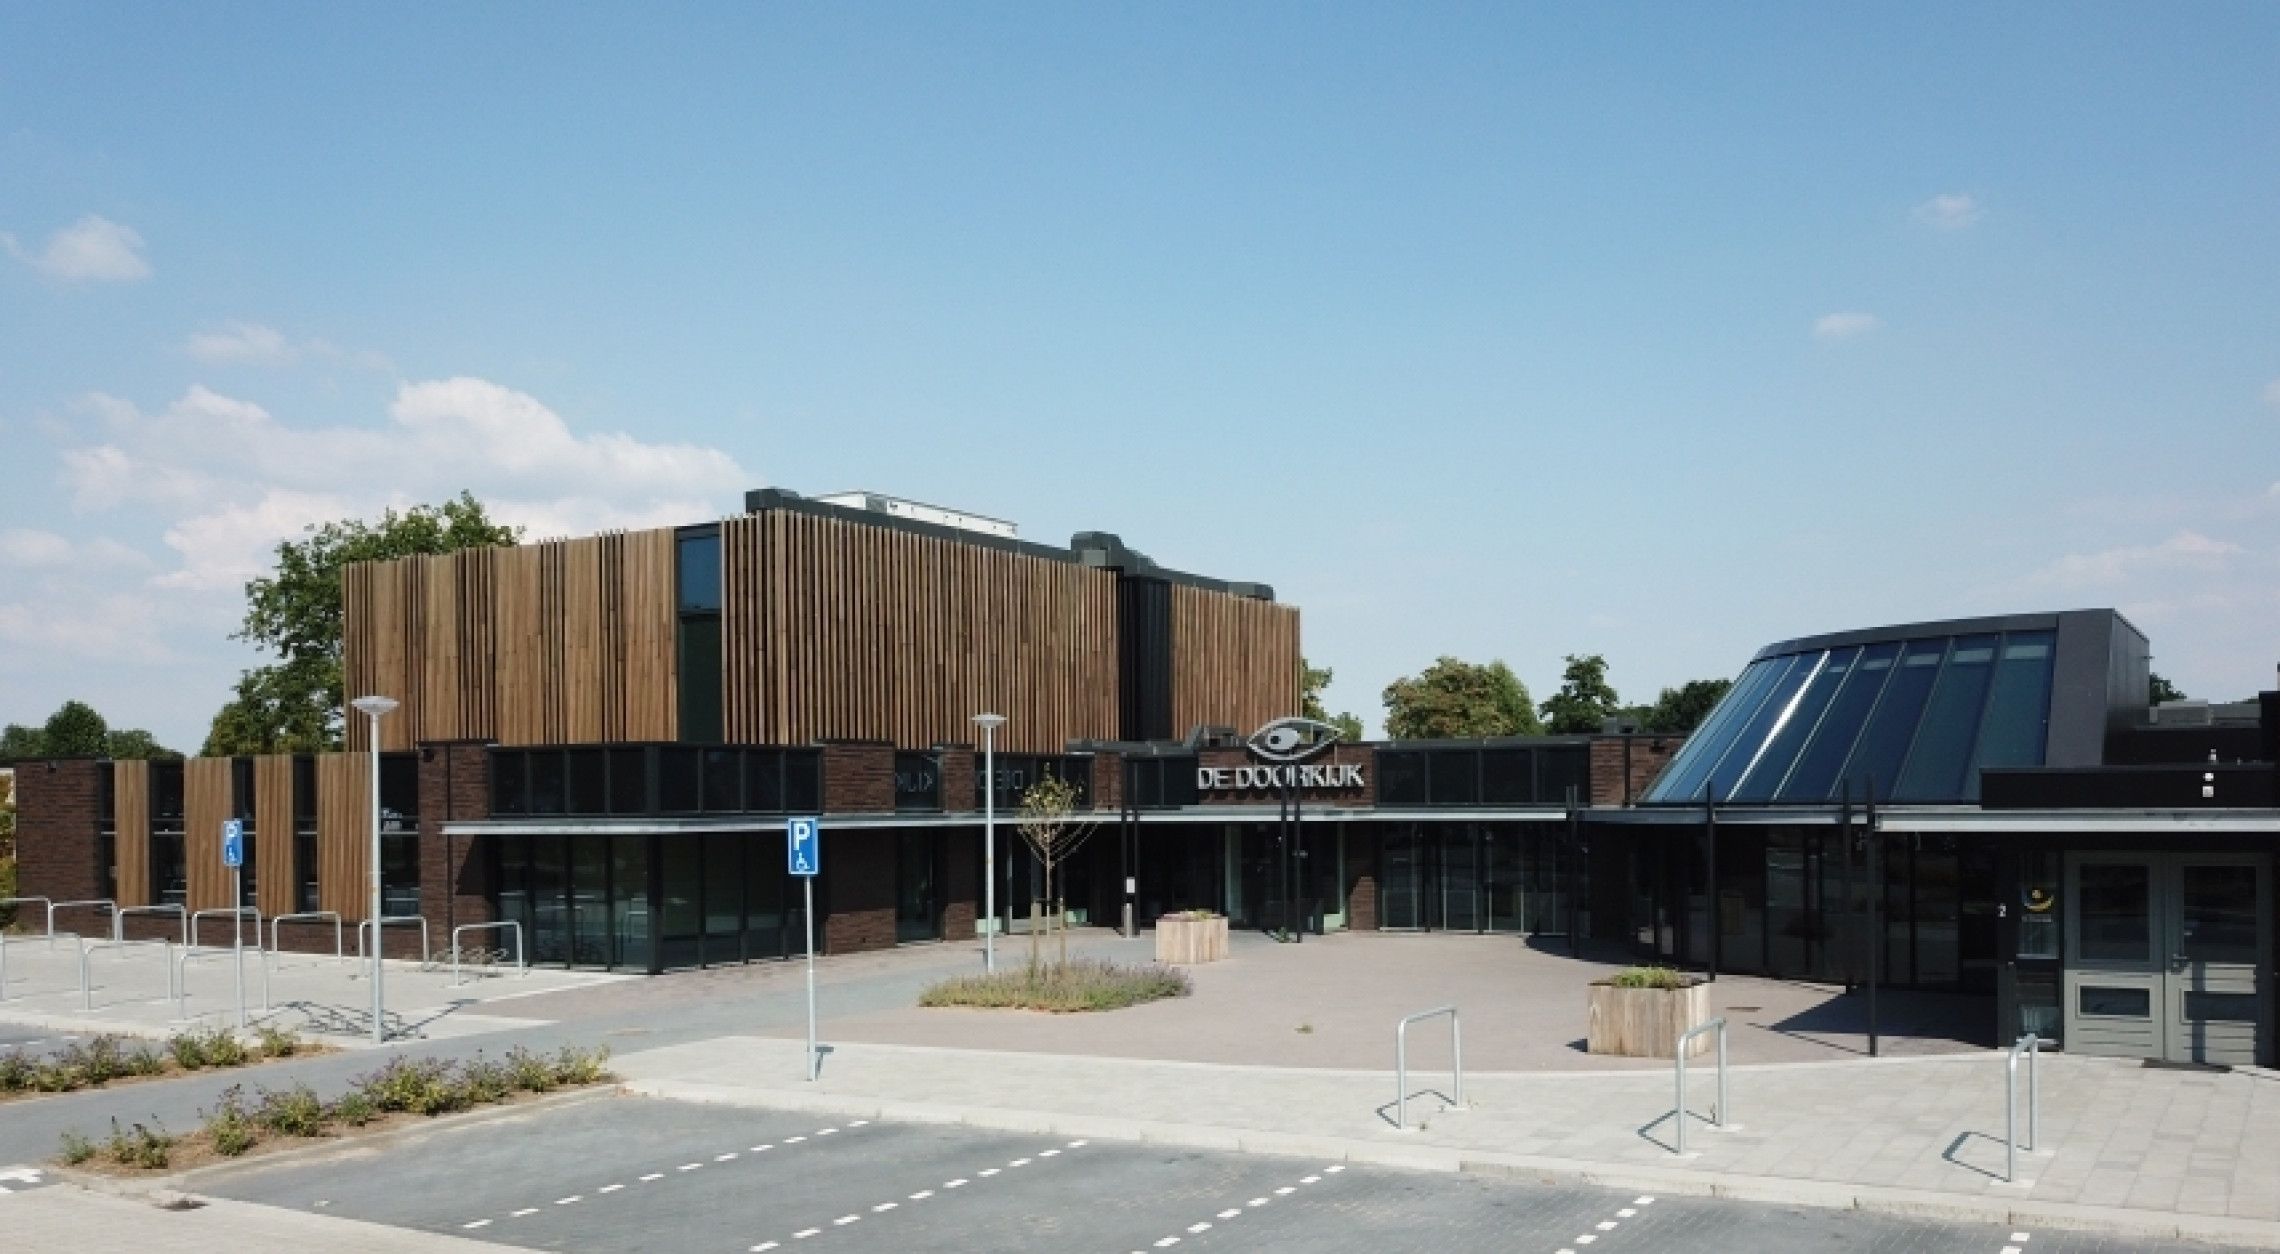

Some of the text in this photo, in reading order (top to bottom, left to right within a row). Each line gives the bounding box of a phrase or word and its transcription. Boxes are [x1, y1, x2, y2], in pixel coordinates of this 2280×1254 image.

[1198, 764, 1365, 790] DE DOORKIJK
[226, 822, 238, 845] P
[793, 822, 811, 850] P
